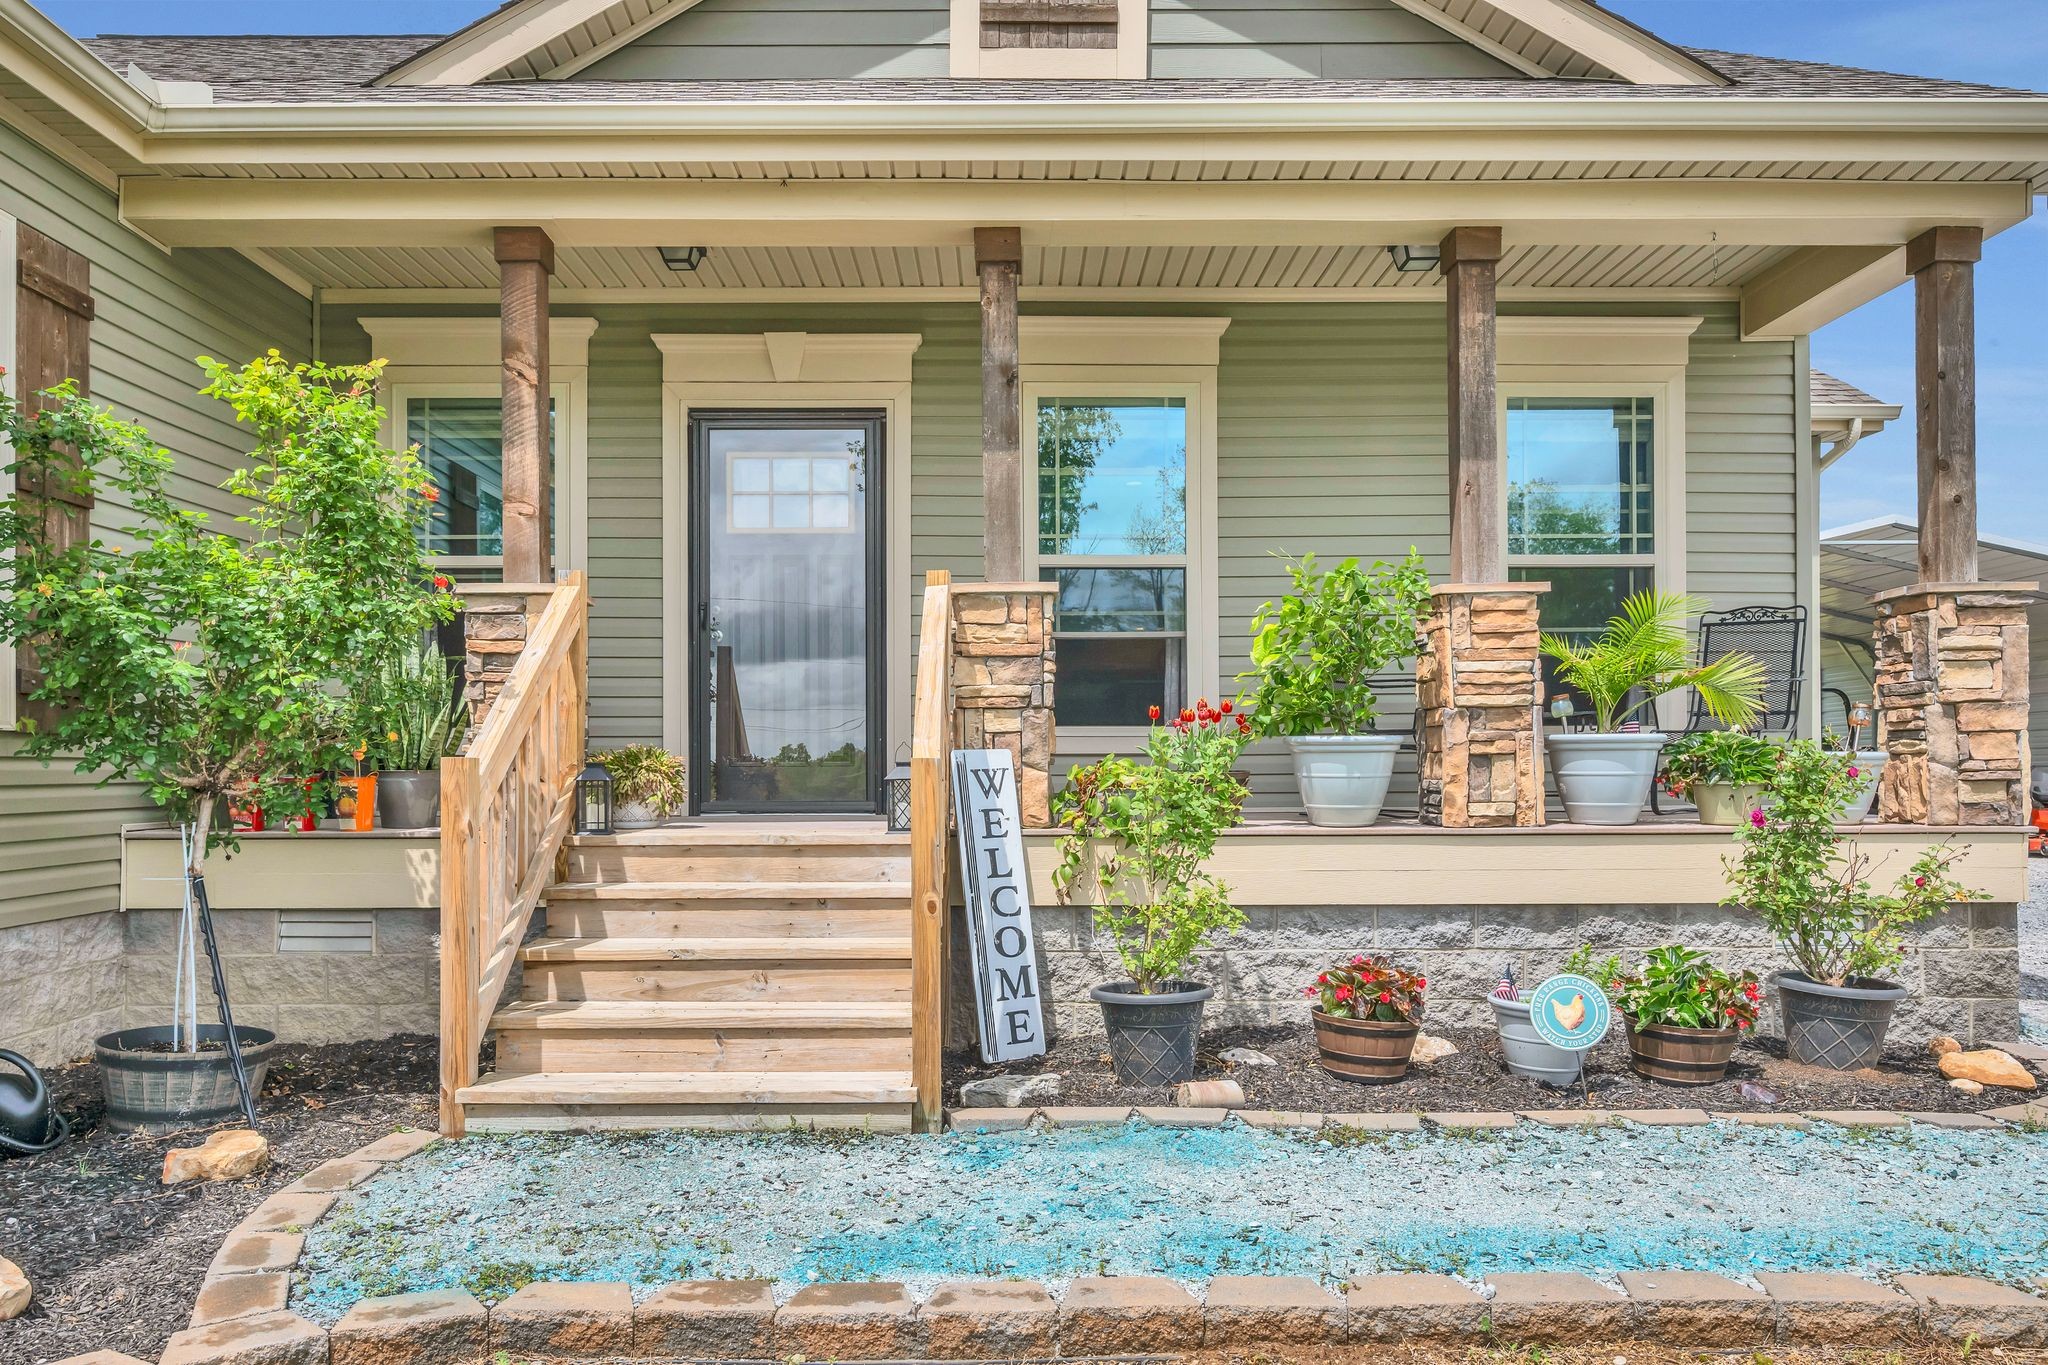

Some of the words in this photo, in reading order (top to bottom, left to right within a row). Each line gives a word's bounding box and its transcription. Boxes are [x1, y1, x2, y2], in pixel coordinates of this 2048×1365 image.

[970, 767, 1035, 1045] WELCOME
[1535, 993, 1545, 1012] FREE
[1544, 979, 1569, 992] RANGE
[1571, 979, 1604, 1007] CHICKENS
[1542, 1028, 1565, 1046] WATCH
[1568, 1039, 1588, 1047] YOUR
[1589, 1024, 1603, 1040] STEP
